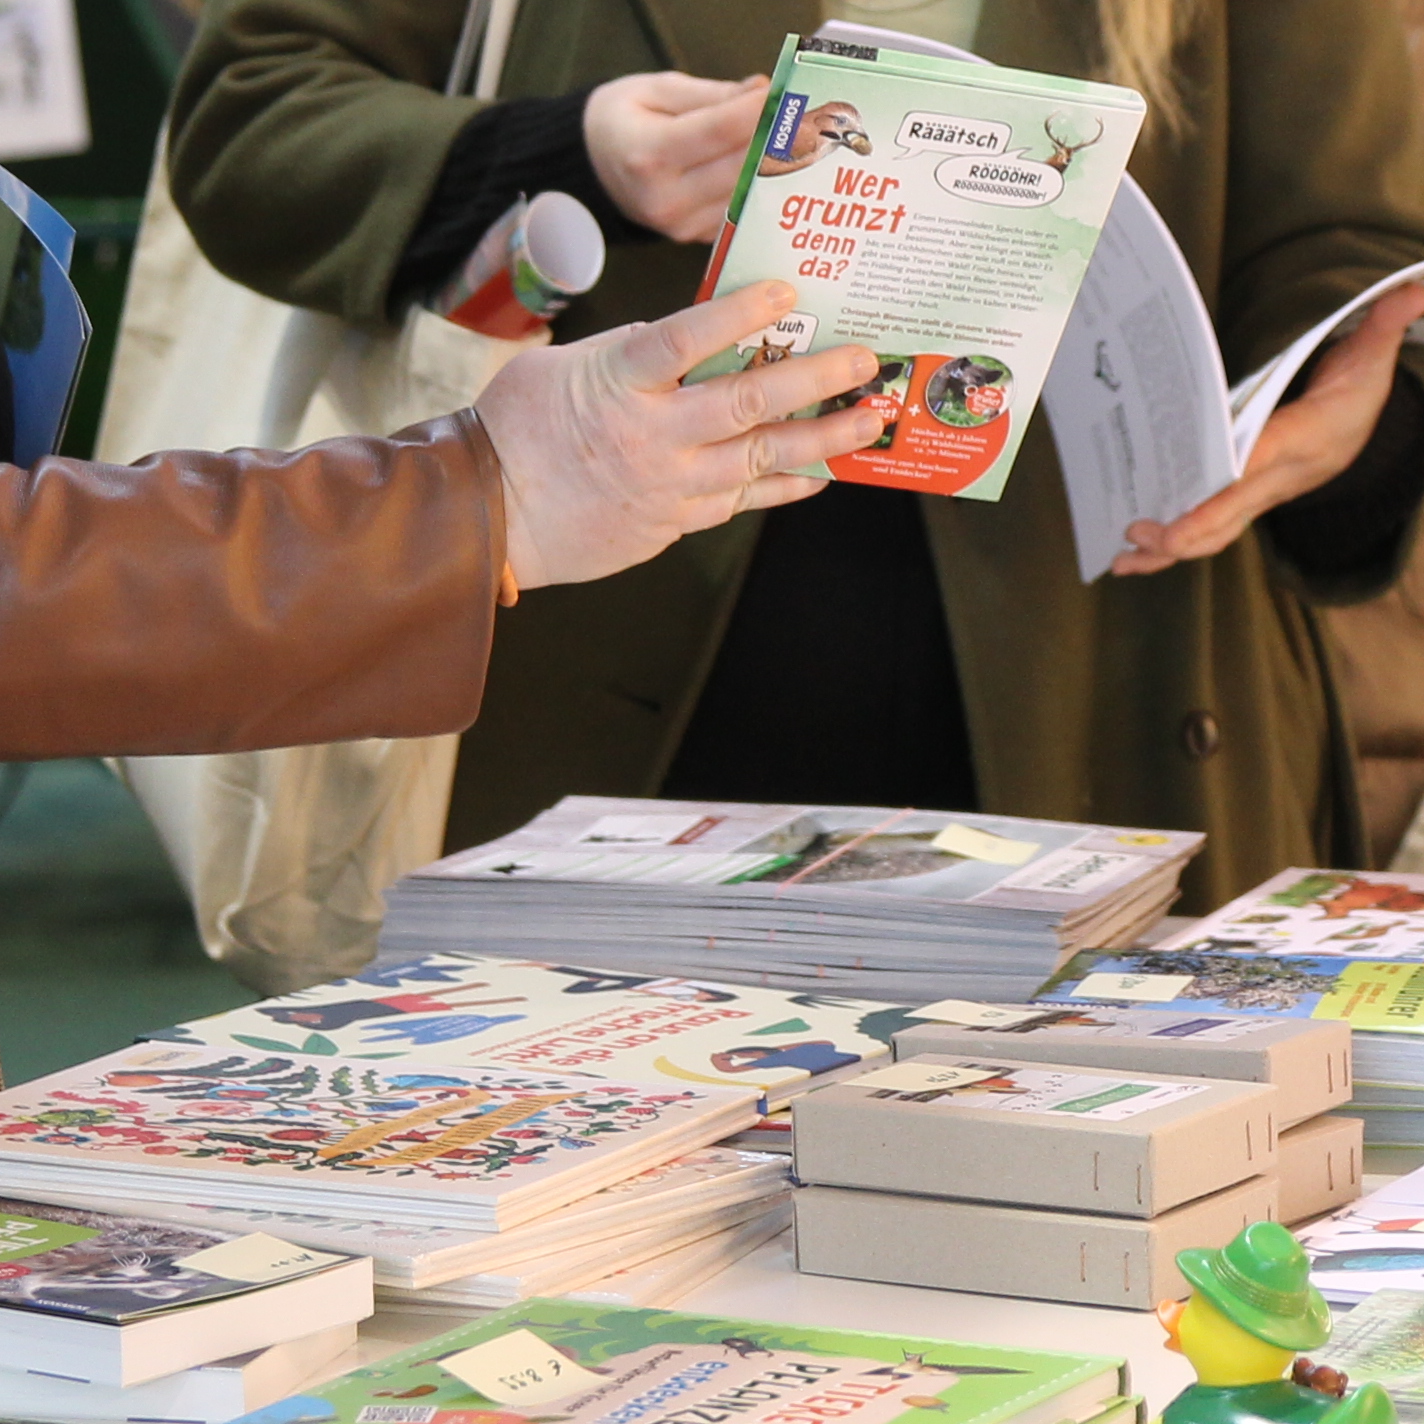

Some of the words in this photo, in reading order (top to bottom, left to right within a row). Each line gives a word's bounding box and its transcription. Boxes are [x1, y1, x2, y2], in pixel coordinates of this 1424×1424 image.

[773, 98, 802, 151] KOSMOS
[833, 166, 900, 201] Wer
[779, 194, 907, 234] grunzt
[791, 228, 856, 256] denn
[798, 256, 849, 281] da?
[574, 1003, 702, 1038] frische
[647, 1010, 753, 1036] Raus
[490, 1037, 597, 1065] Luft!
[611, 1034, 658, 1052] an
[549, 1049, 613, 1066] die
